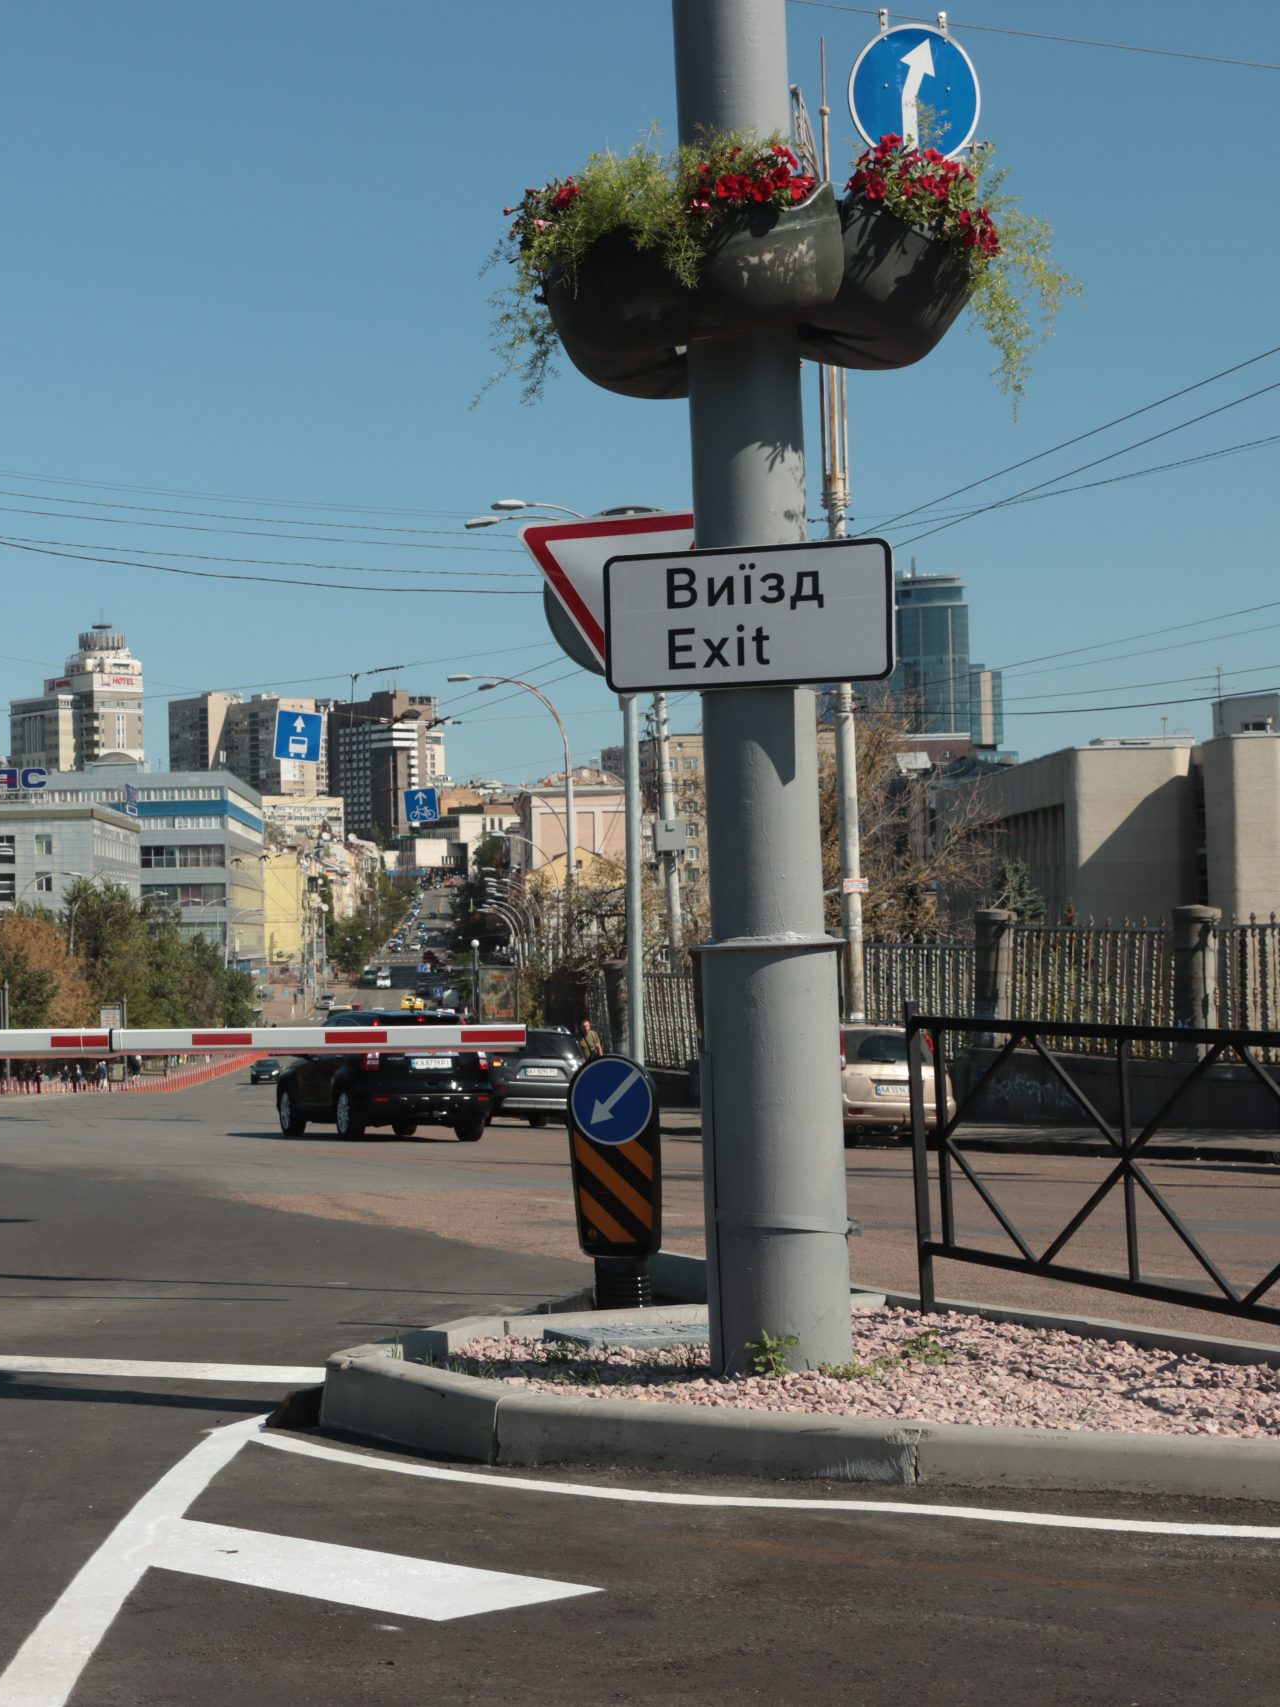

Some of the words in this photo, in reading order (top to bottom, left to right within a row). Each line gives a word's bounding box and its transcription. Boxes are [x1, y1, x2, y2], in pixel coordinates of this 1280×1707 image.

[666, 562, 825, 611] Виїзд
[667, 623, 771, 671] Exit
[112, 676, 135, 686] HOTEL
